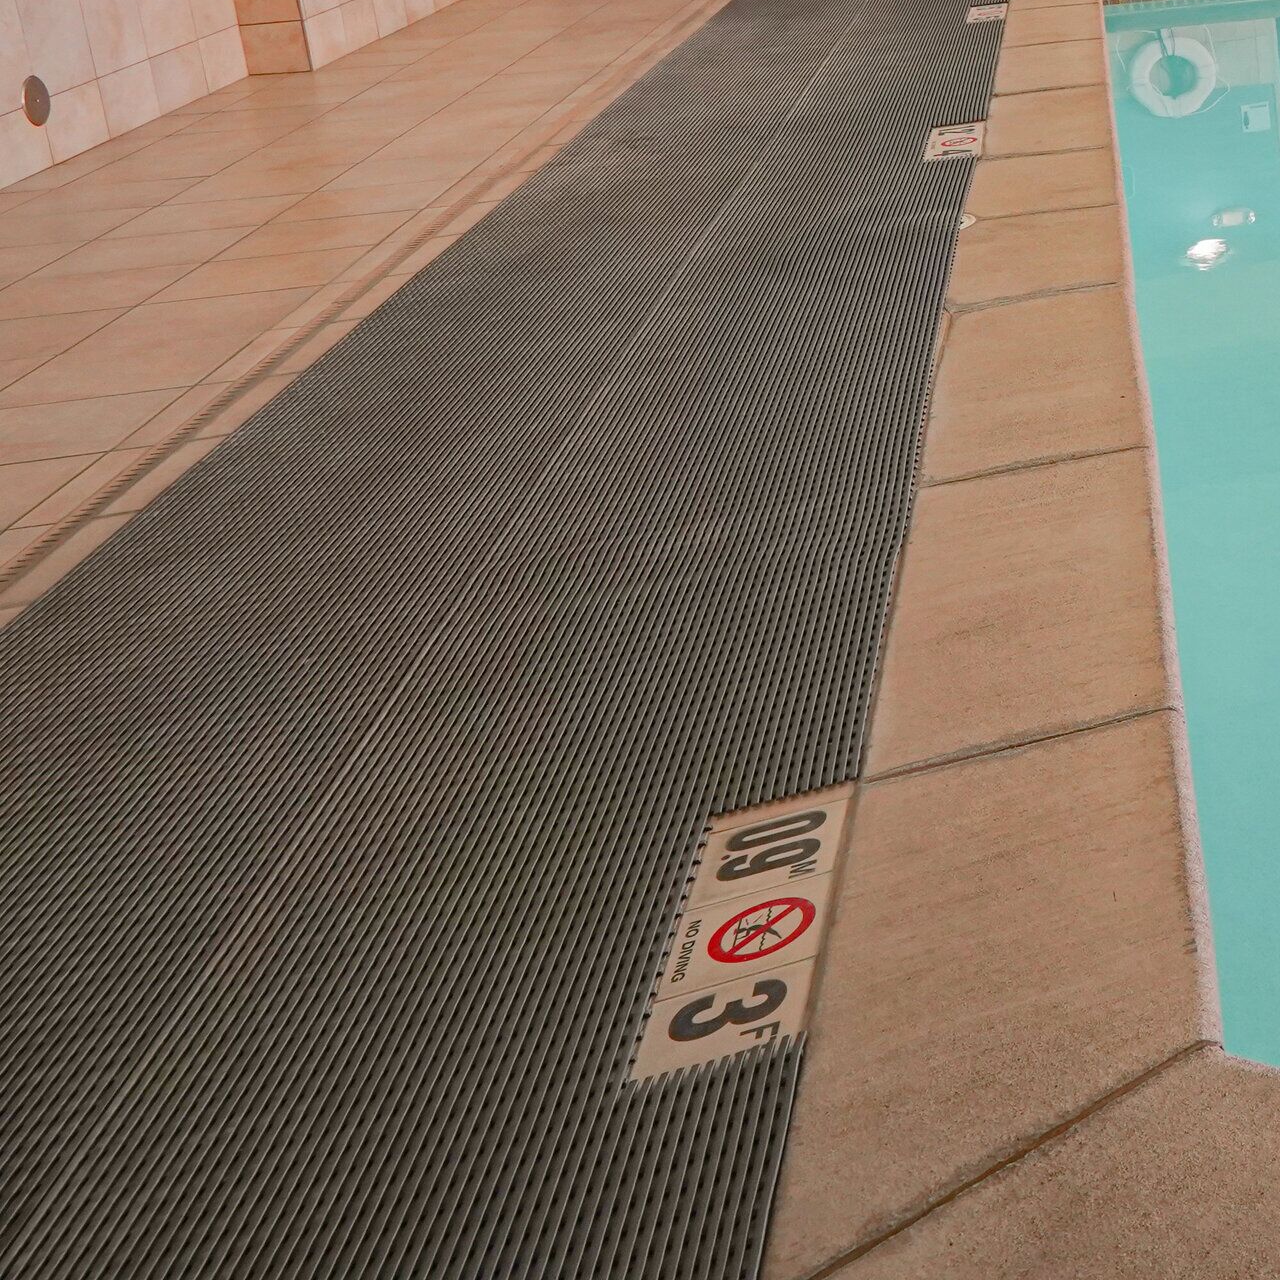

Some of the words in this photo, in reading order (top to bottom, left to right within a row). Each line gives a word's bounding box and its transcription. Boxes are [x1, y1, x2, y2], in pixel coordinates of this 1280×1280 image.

[685, 919, 702, 938] NO
[671, 940, 696, 983] DIVING
[668, 978, 788, 1042] 3
